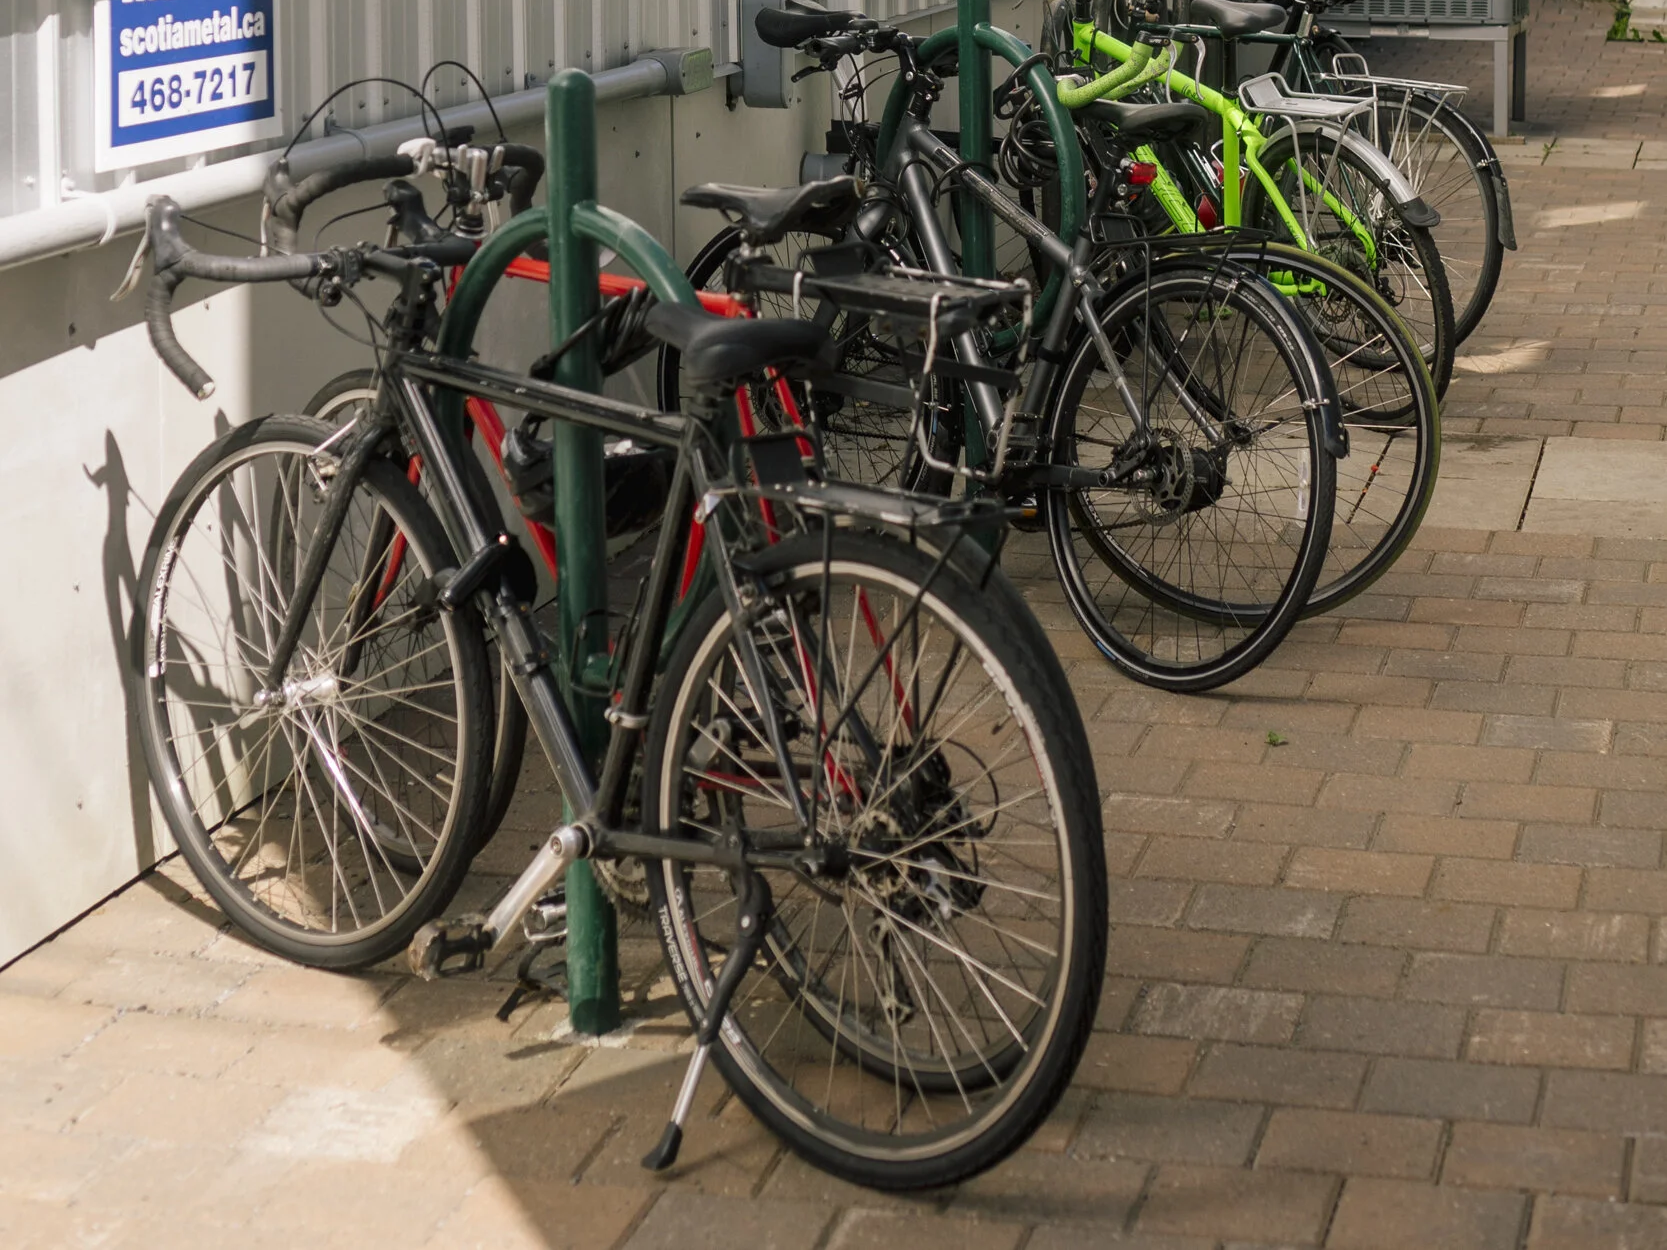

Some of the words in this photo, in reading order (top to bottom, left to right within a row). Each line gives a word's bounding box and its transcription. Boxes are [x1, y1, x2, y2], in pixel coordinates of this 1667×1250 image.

[120, 6, 265, 57] scotiametal.ca
[131, 61, 256, 115] 468-7217
[658, 904, 689, 983] TRAVERSE
